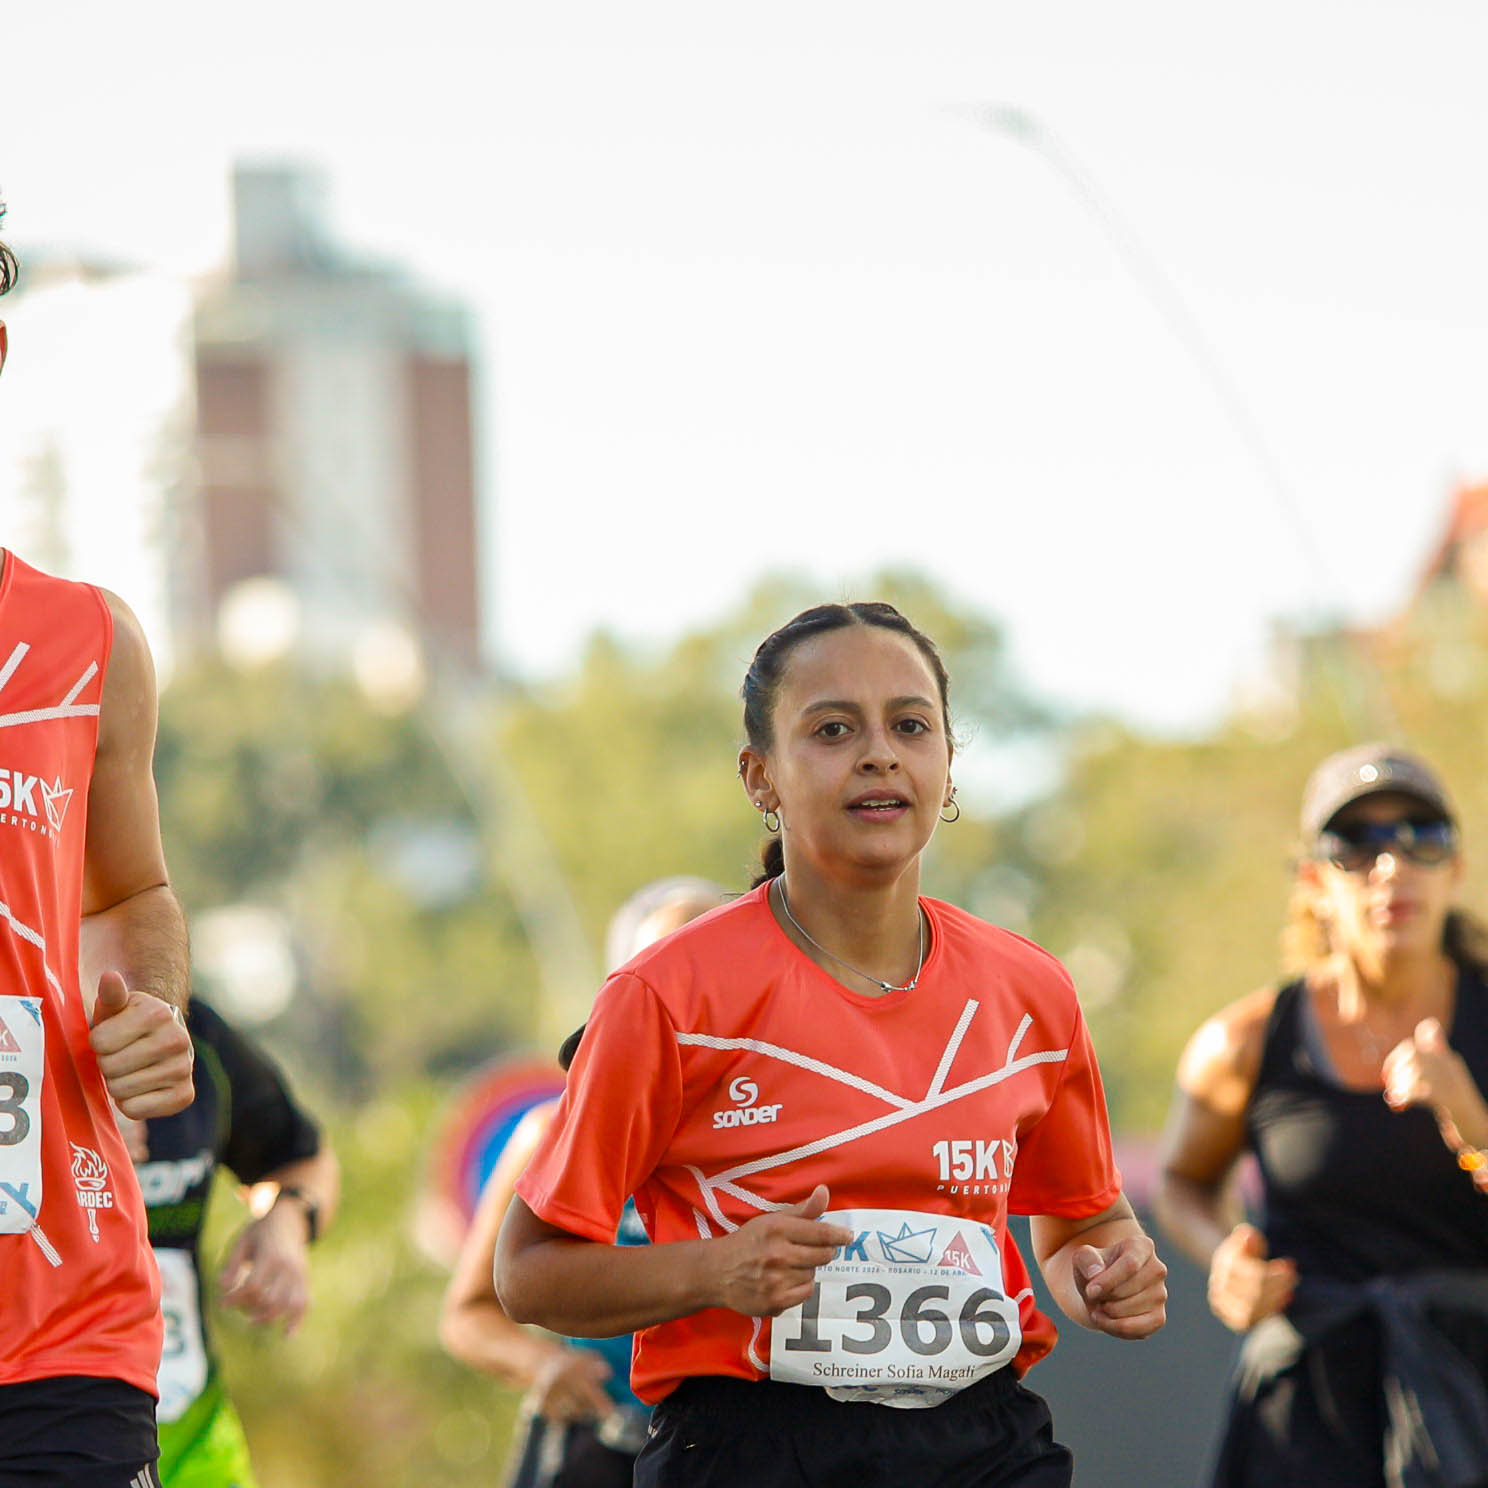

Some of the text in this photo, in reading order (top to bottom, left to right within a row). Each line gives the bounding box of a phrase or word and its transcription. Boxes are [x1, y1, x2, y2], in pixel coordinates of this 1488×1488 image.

[932, 1139, 1001, 1181] 15K
[945, 1249, 971, 1269] 15K
[785, 1282, 1010, 1357] 1366
[813, 1363, 975, 1381] Schreiner Sofia Magali
